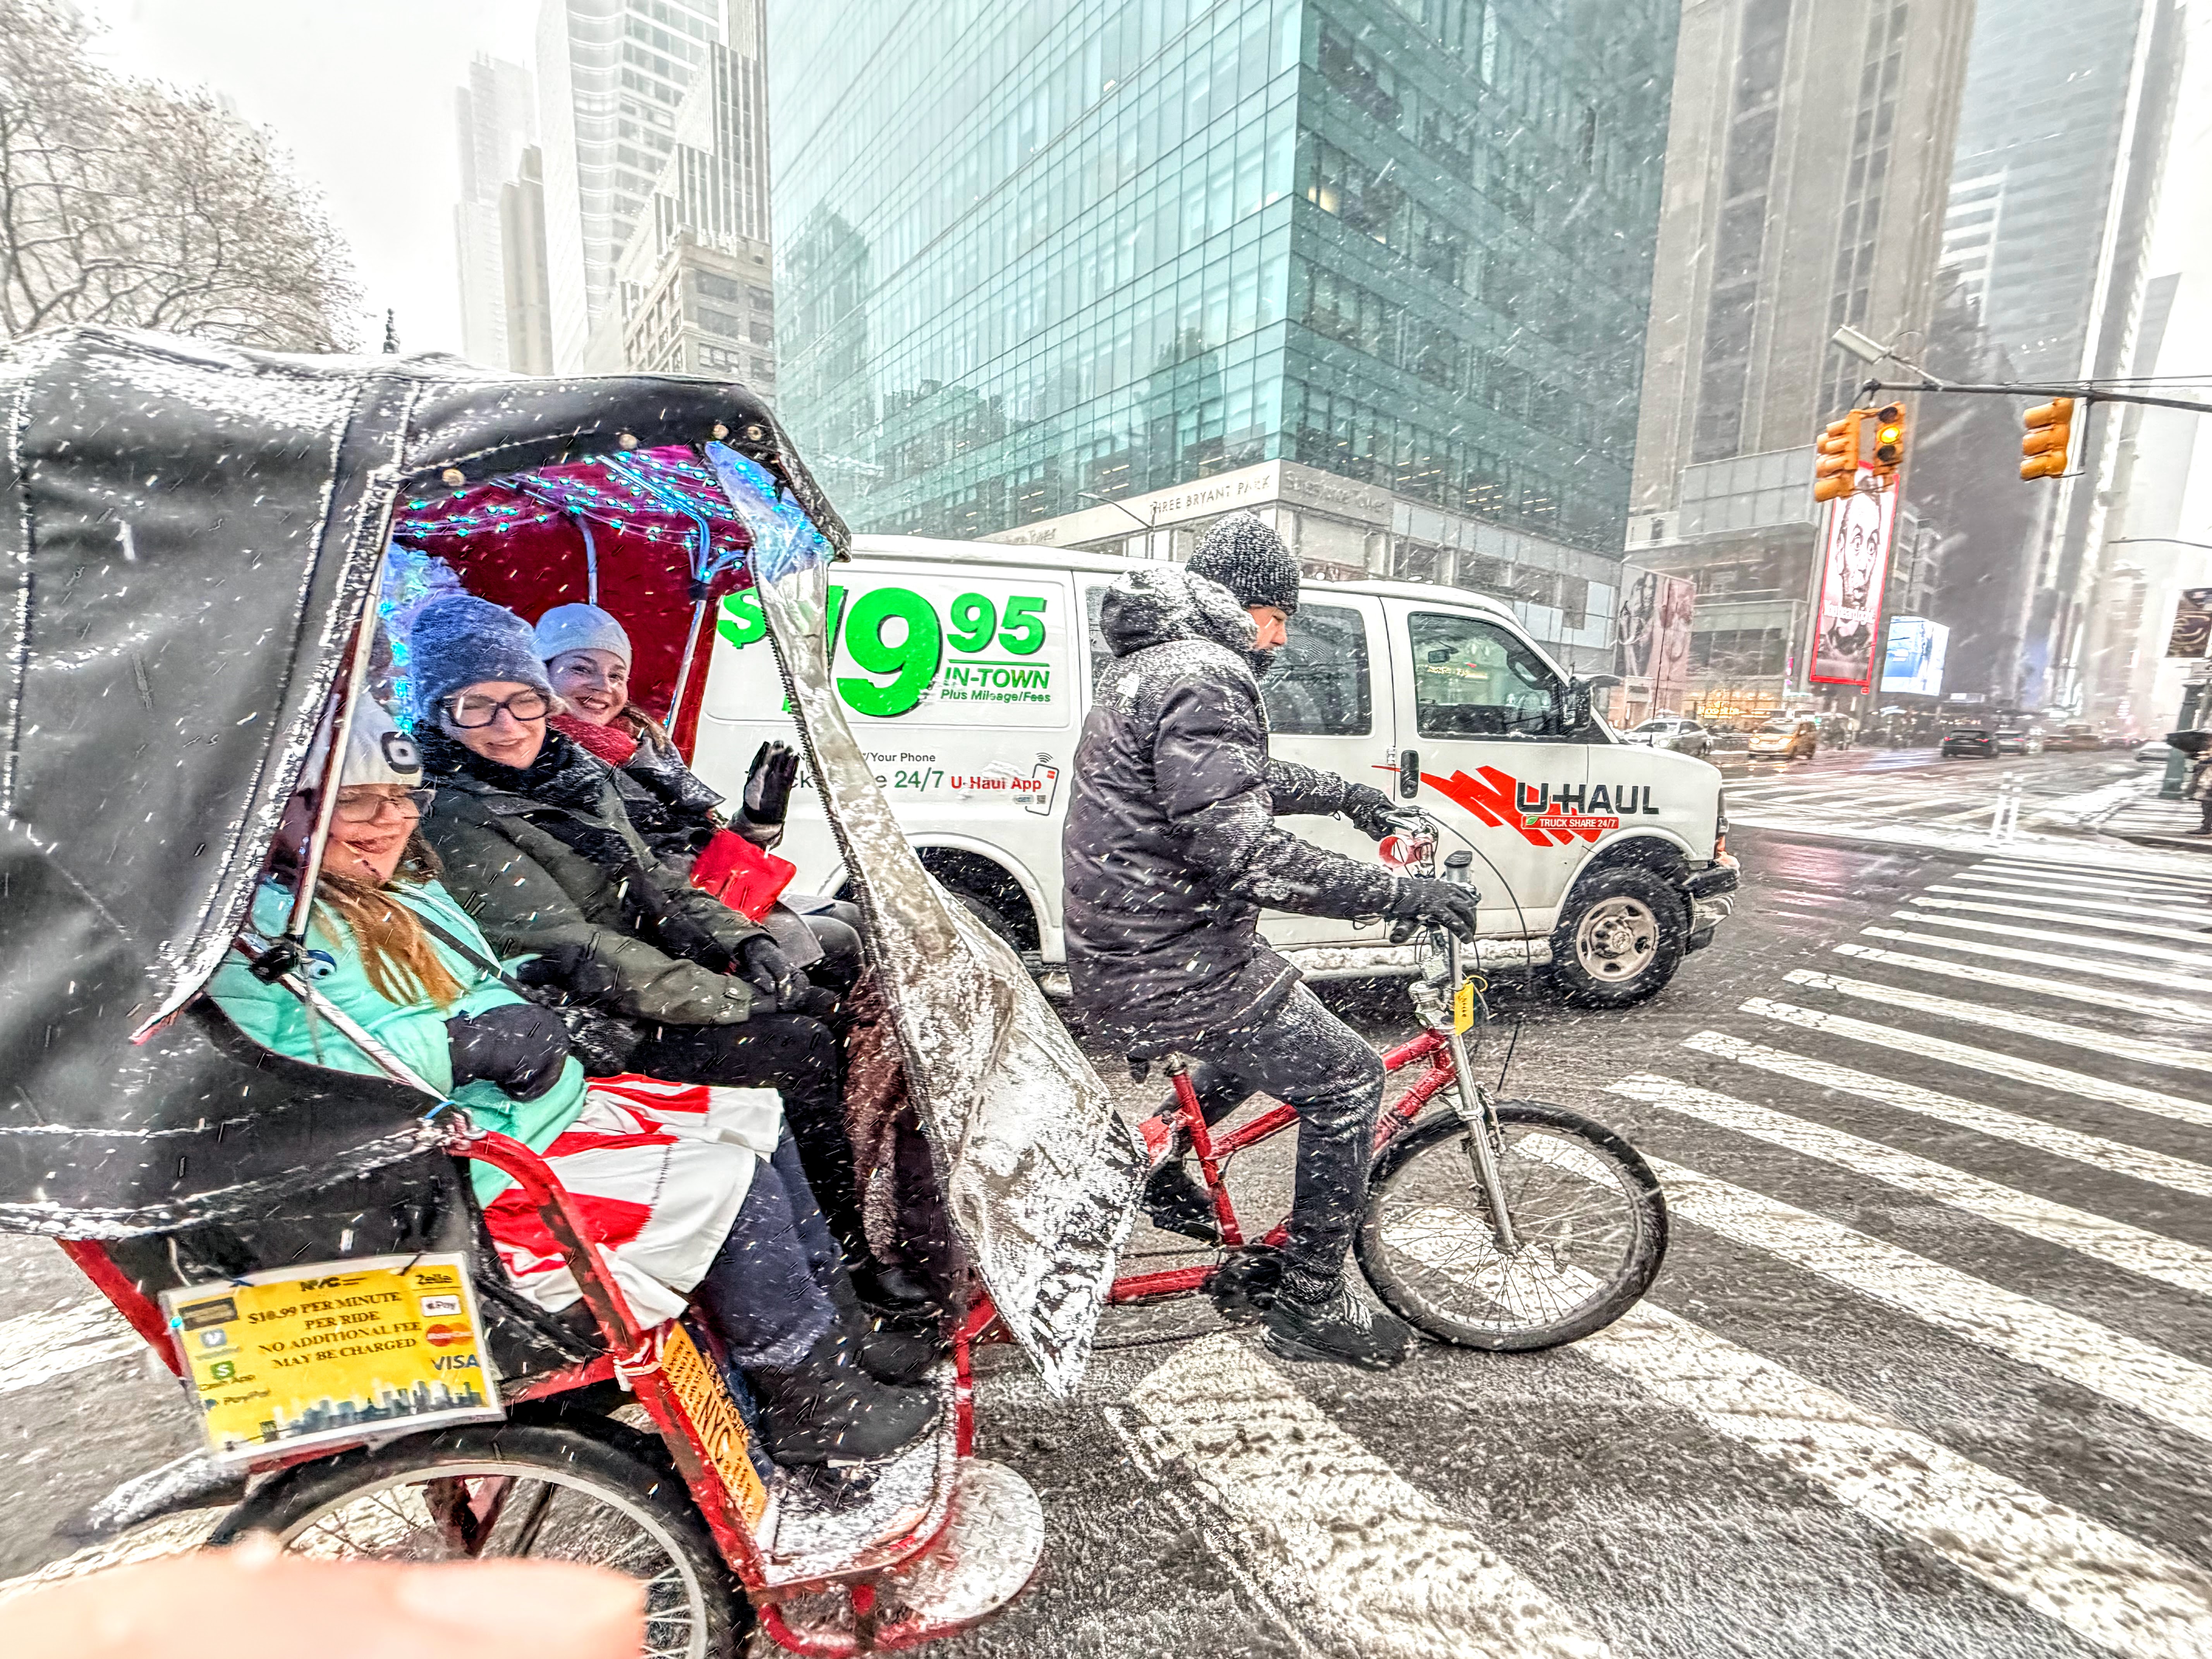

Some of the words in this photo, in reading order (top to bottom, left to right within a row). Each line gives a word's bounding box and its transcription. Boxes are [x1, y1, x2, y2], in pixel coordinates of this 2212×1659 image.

[1186, 486, 1230, 508] BRYANT
[946, 592, 1048, 655] 95
[943, 667, 1050, 689] IN-TOWN
[941, 689, 968, 700] Plus
[970, 690, 1051, 703] Mileage/Fees
[900, 752, 936, 762] Phone
[894, 767, 944, 792] 24/7
[1011, 777, 1042, 792] App
[1516, 782, 1659, 815] U-HAUL
[1540, 819, 1568, 827] TRUCK
[1569, 819, 1596, 828] SHARE
[1597, 819, 1616, 828] 24/7
[300, 1300, 333, 1313] PER
[335, 1292, 403, 1308] MINUTE
[305, 1317, 337, 1329] PER
[339, 1311, 381, 1324] RIDE
[259, 1342, 285, 1352] NO
[291, 1326, 387, 1348] ADDITIONAL
[394, 1322, 422, 1332] FEE
[272, 1355, 309, 1368] MAY
[316, 1349, 338, 1360] BE
[340, 1338, 417, 1356] CHARGED
[430, 1354, 481, 1370] VISA
